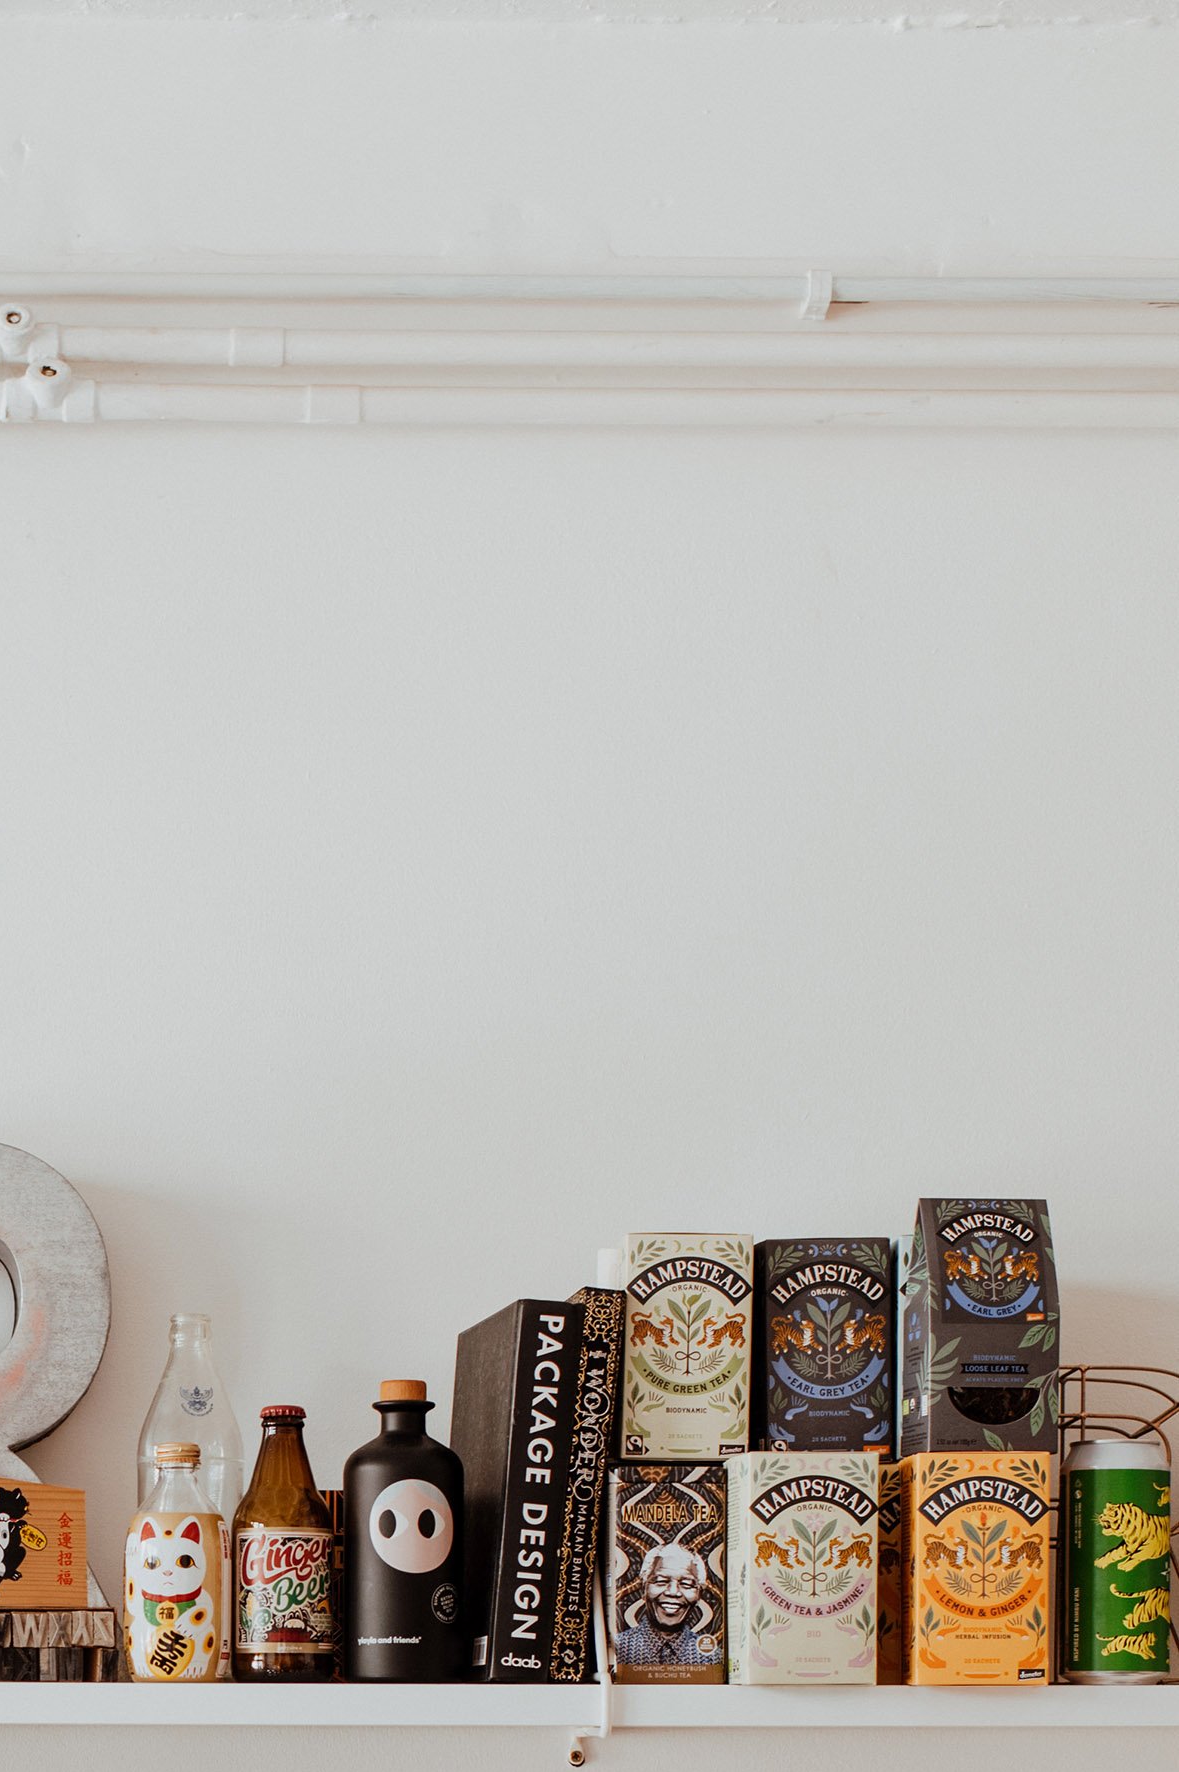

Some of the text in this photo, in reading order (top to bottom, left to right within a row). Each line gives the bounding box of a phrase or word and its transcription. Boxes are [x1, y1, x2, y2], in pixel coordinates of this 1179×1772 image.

[941, 1213, 1034, 1242] HAMPSTEAD
[973, 1231, 1003, 1239] ORGANIC
[631, 1260, 747, 1299] HAMPSTEAD
[671, 1284, 708, 1293] ORGANIC
[771, 1264, 884, 1304] HAMPSTEAD
[810, 1288, 847, 1297] ORGANIC
[971, 1304, 1017, 1317] EARL GREY
[645, 1371, 730, 1394] PURE GREEN TEA
[789, 1377, 868, 1397] EARL GREY TEA
[570, 1367, 611, 1502] WONDER
[511, 1314, 566, 1640] PACKAGE DESIGN
[755, 1478, 873, 1519] HAMPSTEAD
[796, 1503, 833, 1513] ORGANIC
[923, 1480, 1043, 1521] HAMPSTEAD
[965, 1505, 1003, 1514] ORGANIC
[622, 1503, 719, 1523] MANDELA TEA
[56, 1511, 74, 1586] 金運招福
[242, 1533, 332, 1587] Ginger
[568, 1503, 589, 1612] MARIAN BANTJES
[271, 1573, 331, 1613] Beer
[764, 1586, 864, 1616] GREEN TEA & JASMINE
[158, 1606, 175, 1620] 福
[939, 1594, 1029, 1617] LEMON & GINGER
[806, 1630, 821, 1638] BIO
[1073, 1624, 1080, 1632] BY
[378, 1636, 392, 1644] and
[501, 1652, 542, 1669] daab
